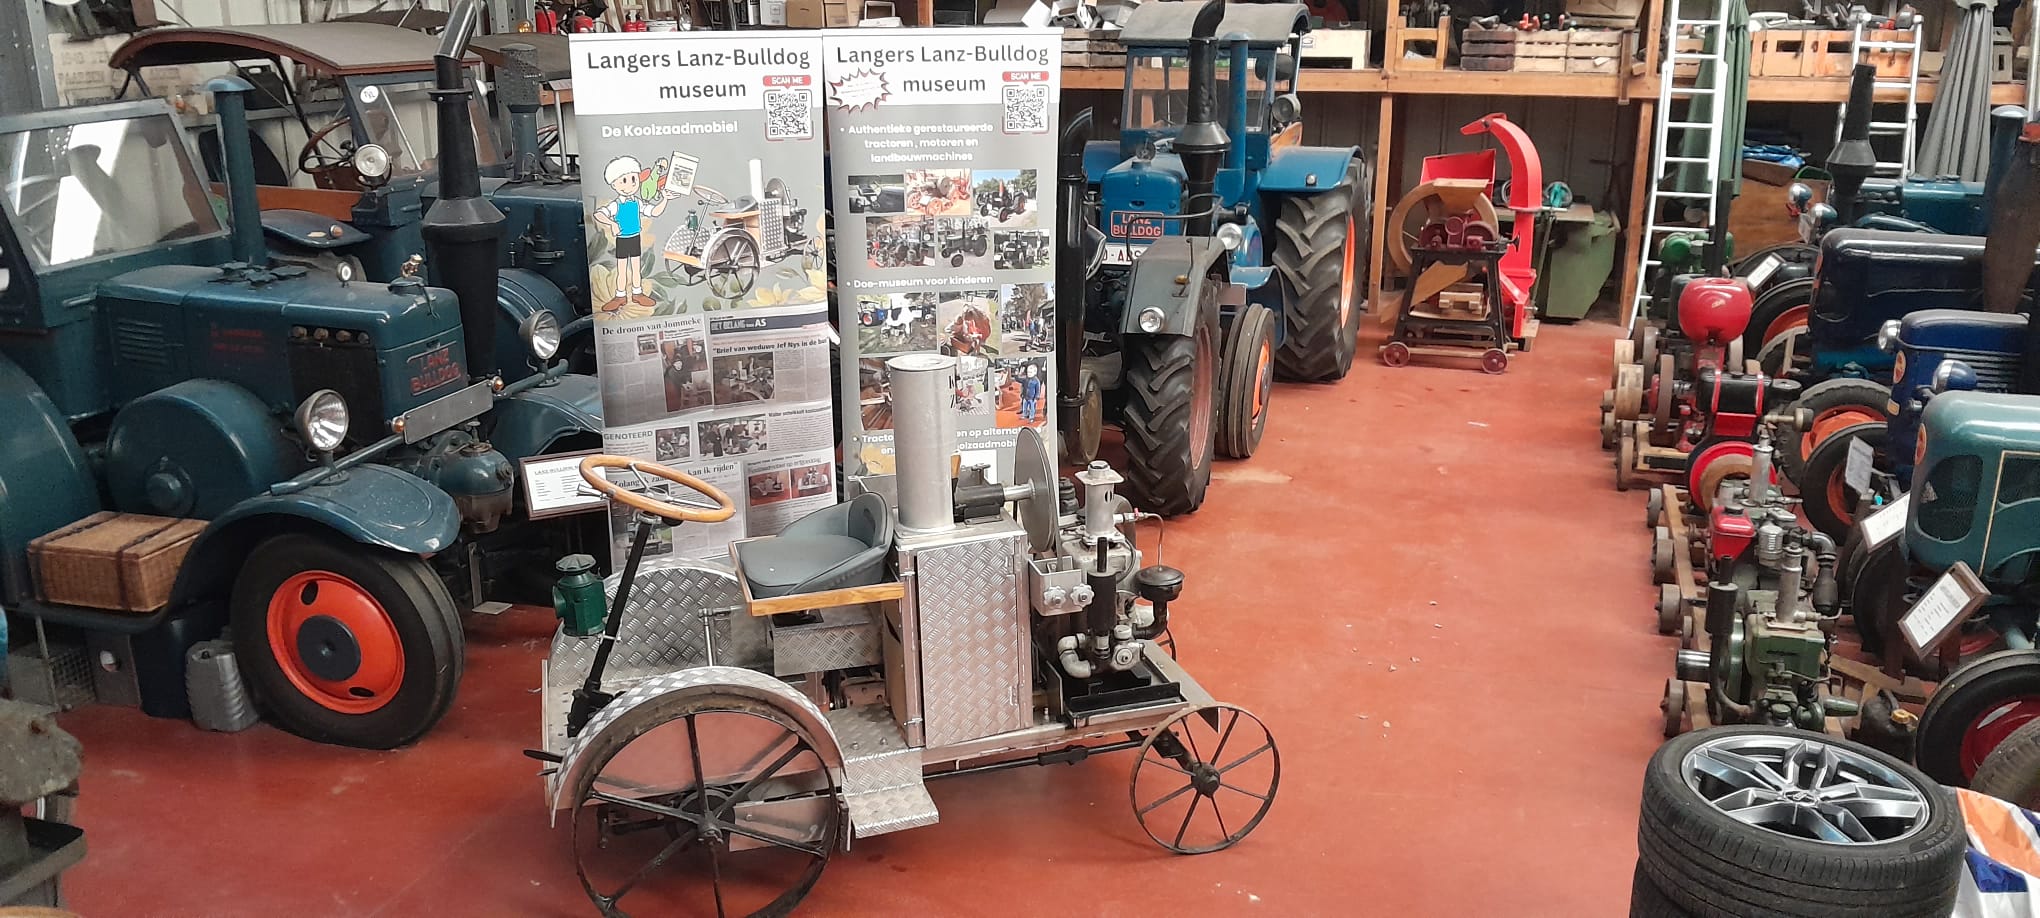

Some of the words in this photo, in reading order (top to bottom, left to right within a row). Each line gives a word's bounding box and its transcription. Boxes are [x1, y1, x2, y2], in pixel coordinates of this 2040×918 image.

[587, 51, 671, 73] Langers
[677, 48, 810, 69] Lanz-Bulldog
[837, 46, 915, 67] Langers
[921, 45, 1049, 66] Lanz-Bulldog
[771, 76, 790, 85] SCAN
[791, 76, 804, 85] ME
[1010, 72, 1028, 81] SCAN
[1029, 72, 1042, 81] ME
[659, 83, 746, 99] museum
[903, 78, 986, 93] museum
[601, 125, 622, 138] De
[623, 121, 738, 138] Koolzaadmobiel
[848, 124, 913, 135] Authentieke
[913, 123, 994, 135] gerestaureerde
[919, 138, 964, 148] motoren
[965, 138, 979, 147] en
[871, 151, 973, 163] landbouwmachines
[853, 278, 924, 289] Doe-museum
[924, 278, 949, 287] voor
[949, 275, 994, 286] kinderen
[602, 327, 615, 336] De
[616, 325, 645, 335] droom
[646, 322, 662, 331] van
[663, 317, 702, 329] Jommeke
[755, 318, 767, 328] AS
[603, 430, 654, 441] GENOTEERD
[861, 434, 895, 443] Tracto
[968, 429, 982, 439] op
[703, 466, 713, 475] ik
